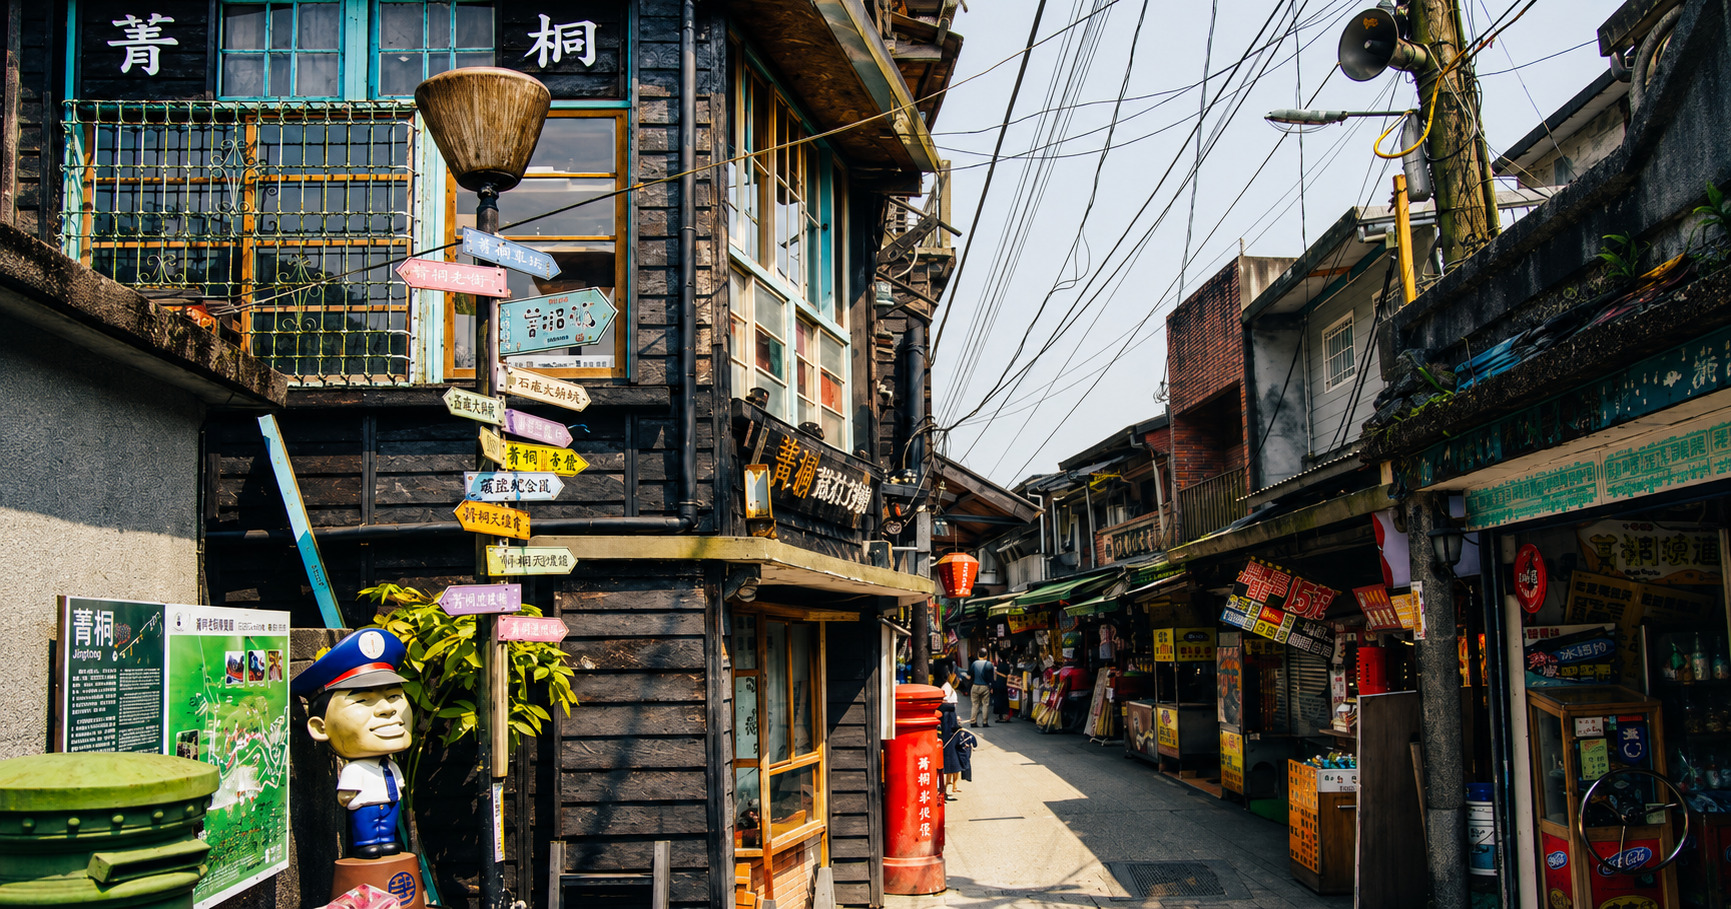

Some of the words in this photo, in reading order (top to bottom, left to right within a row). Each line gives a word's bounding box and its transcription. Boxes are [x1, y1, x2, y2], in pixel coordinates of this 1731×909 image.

[107, 13, 178, 76] 菁
[525, 13, 597, 69] 桐
[72, 607, 115, 648] 菁桐
